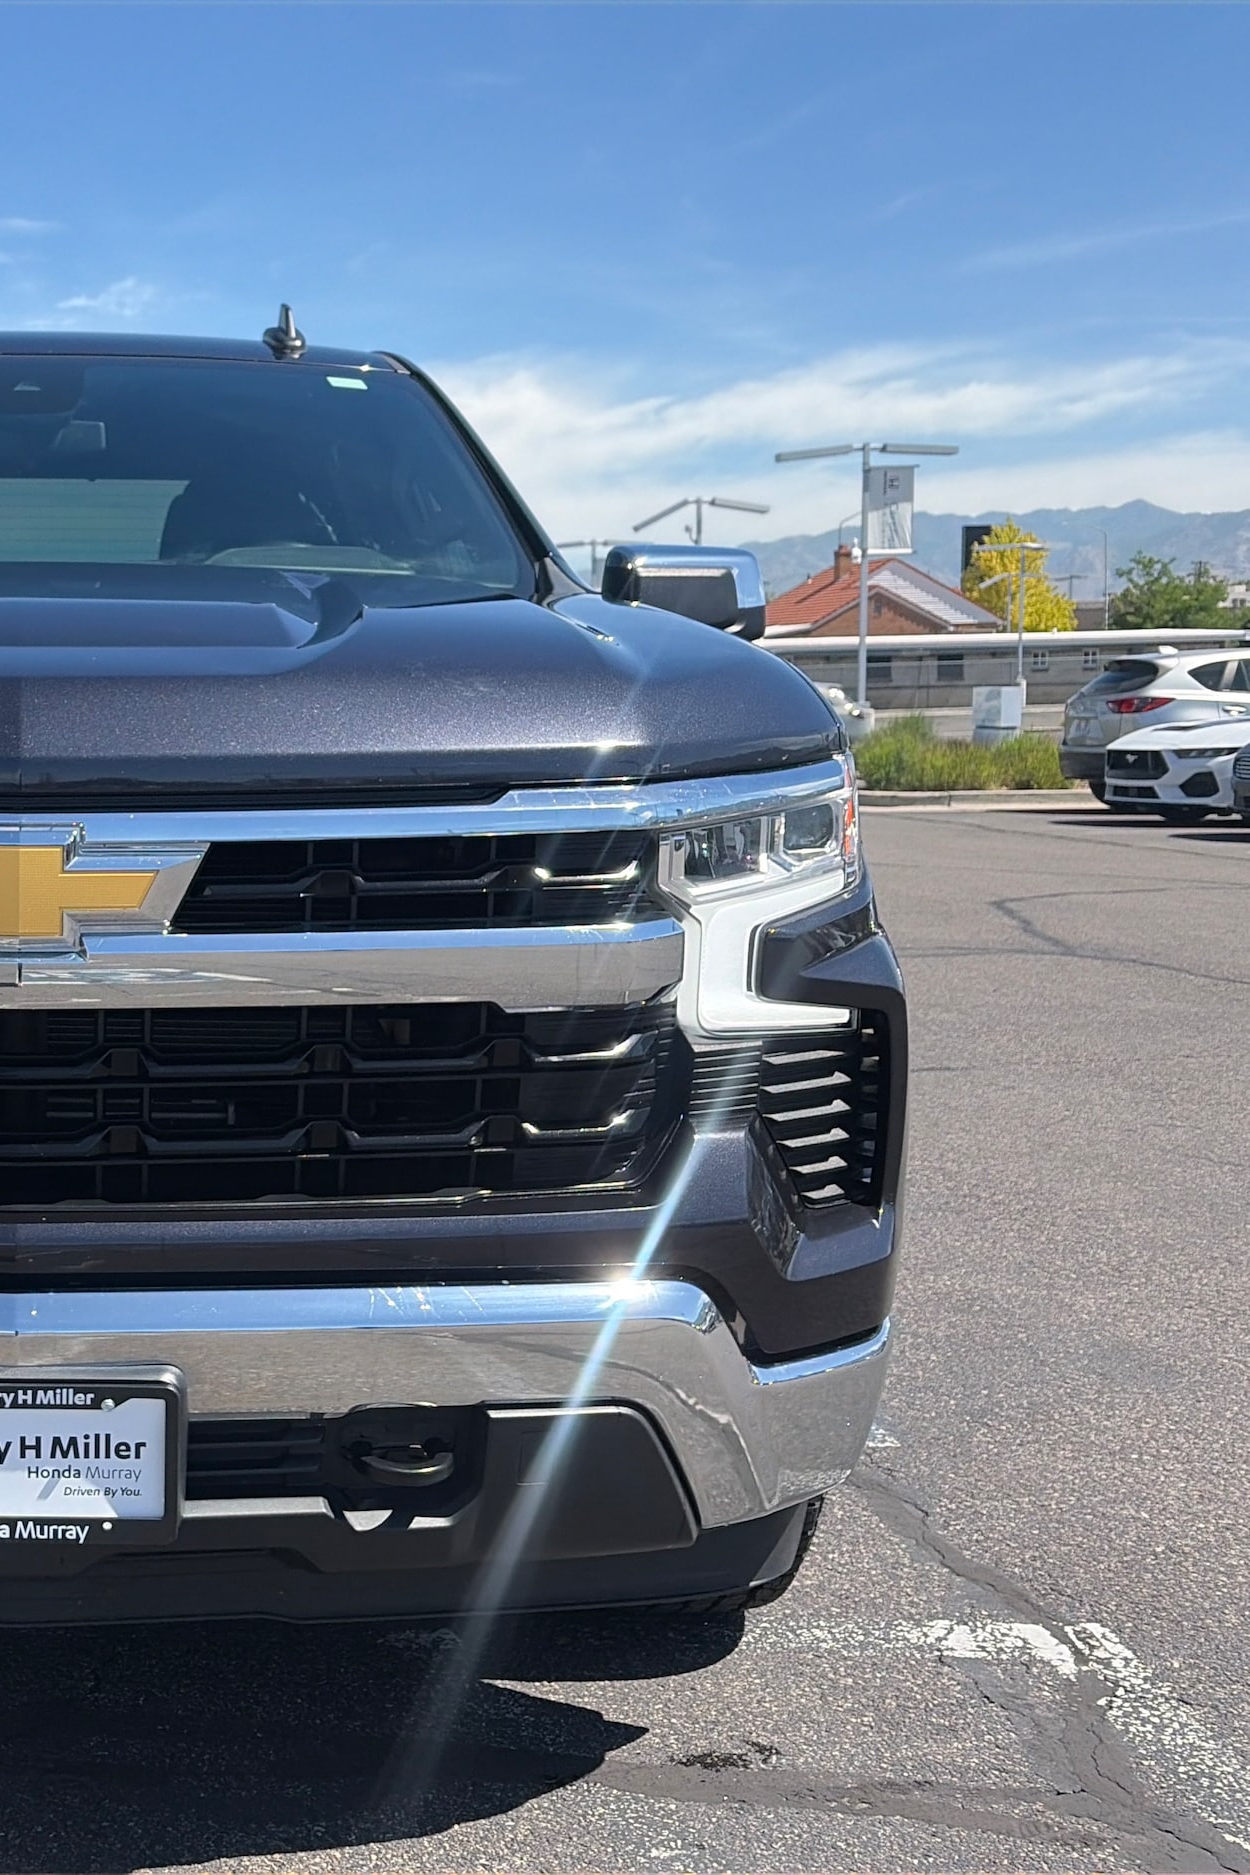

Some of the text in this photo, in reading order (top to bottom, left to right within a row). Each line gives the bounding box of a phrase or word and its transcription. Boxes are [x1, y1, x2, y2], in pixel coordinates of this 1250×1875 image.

[18, 1390, 33, 1405] H
[36, 1389, 95, 1406] Miller
[20, 1436, 42, 1459] H
[50, 1434, 146, 1460] Miller
[27, 1464, 142, 1483] Honda Murray
[64, 1486, 143, 1498] Driven By You.
[14, 1521, 89, 1544] Murray
